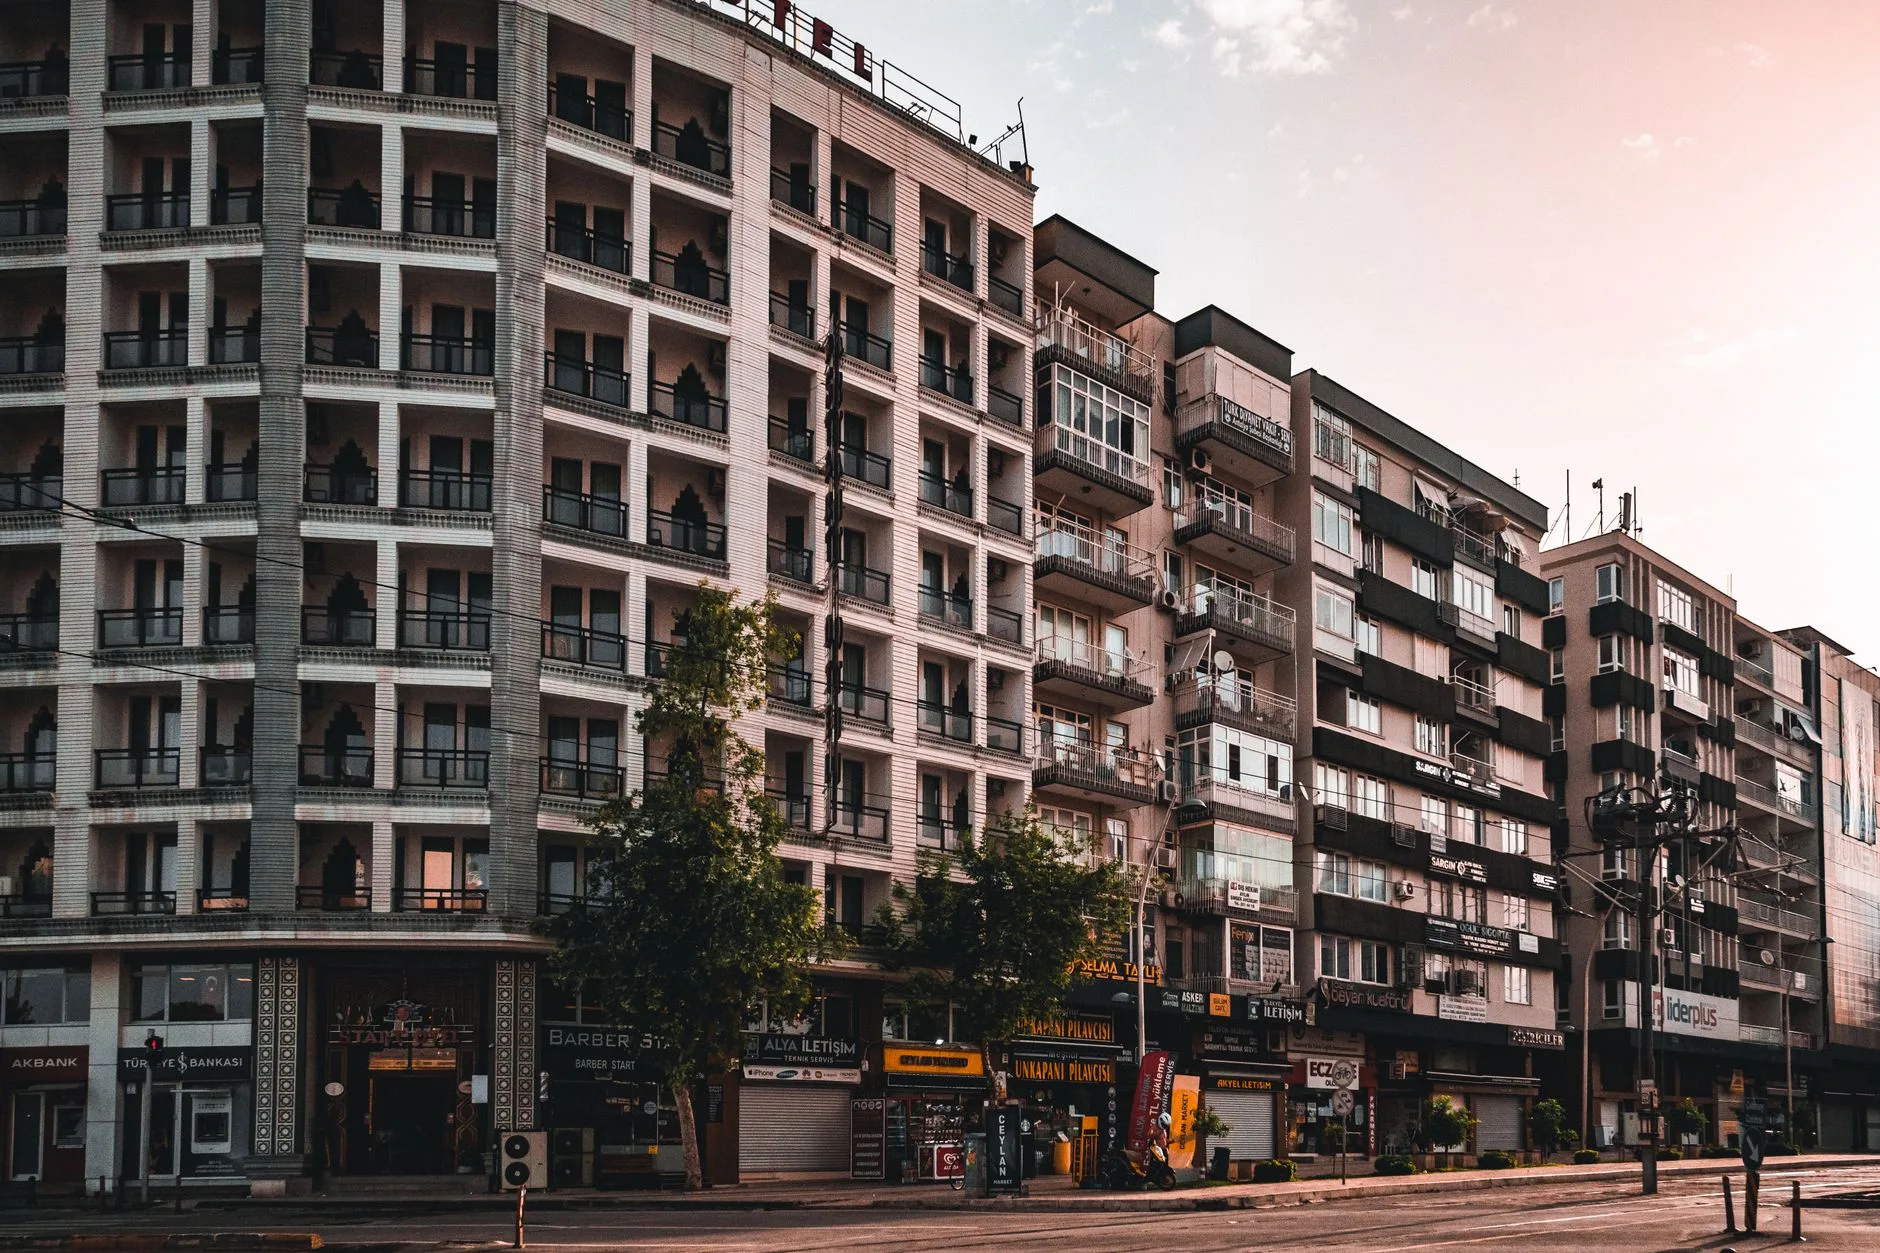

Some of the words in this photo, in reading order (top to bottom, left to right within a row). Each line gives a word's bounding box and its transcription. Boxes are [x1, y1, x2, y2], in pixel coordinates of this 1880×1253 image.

[1080, 959, 1118, 975] SELMA
[1123, 962, 1155, 978] TALI
[1181, 991, 1204, 1003] ASKER
[1666, 996, 1718, 1028] liderplus
[549, 1029, 630, 1048] BARBER
[764, 1037, 799, 1051] ALYA
[801, 1036, 856, 1057] İLETİŞİM
[11, 1056, 79, 1068] AKBANK
[124, 1057, 175, 1069] TÜRYE
[190, 1057, 243, 1068] BANKASI
[575, 1058, 607, 1069] BARBER
[611, 1060, 636, 1070] START
[1015, 1059, 1065, 1080] UNKAPANI
[753, 1069, 774, 1077] iPhone
[1152, 1056, 1166, 1101] yükleme
[1148, 1100, 1159, 1117] TL
[1181, 1093, 1189, 1121] MARKET
[1368, 1095, 1376, 1150] PHARMACY
[998, 1114, 1007, 1177] CEYLAN
